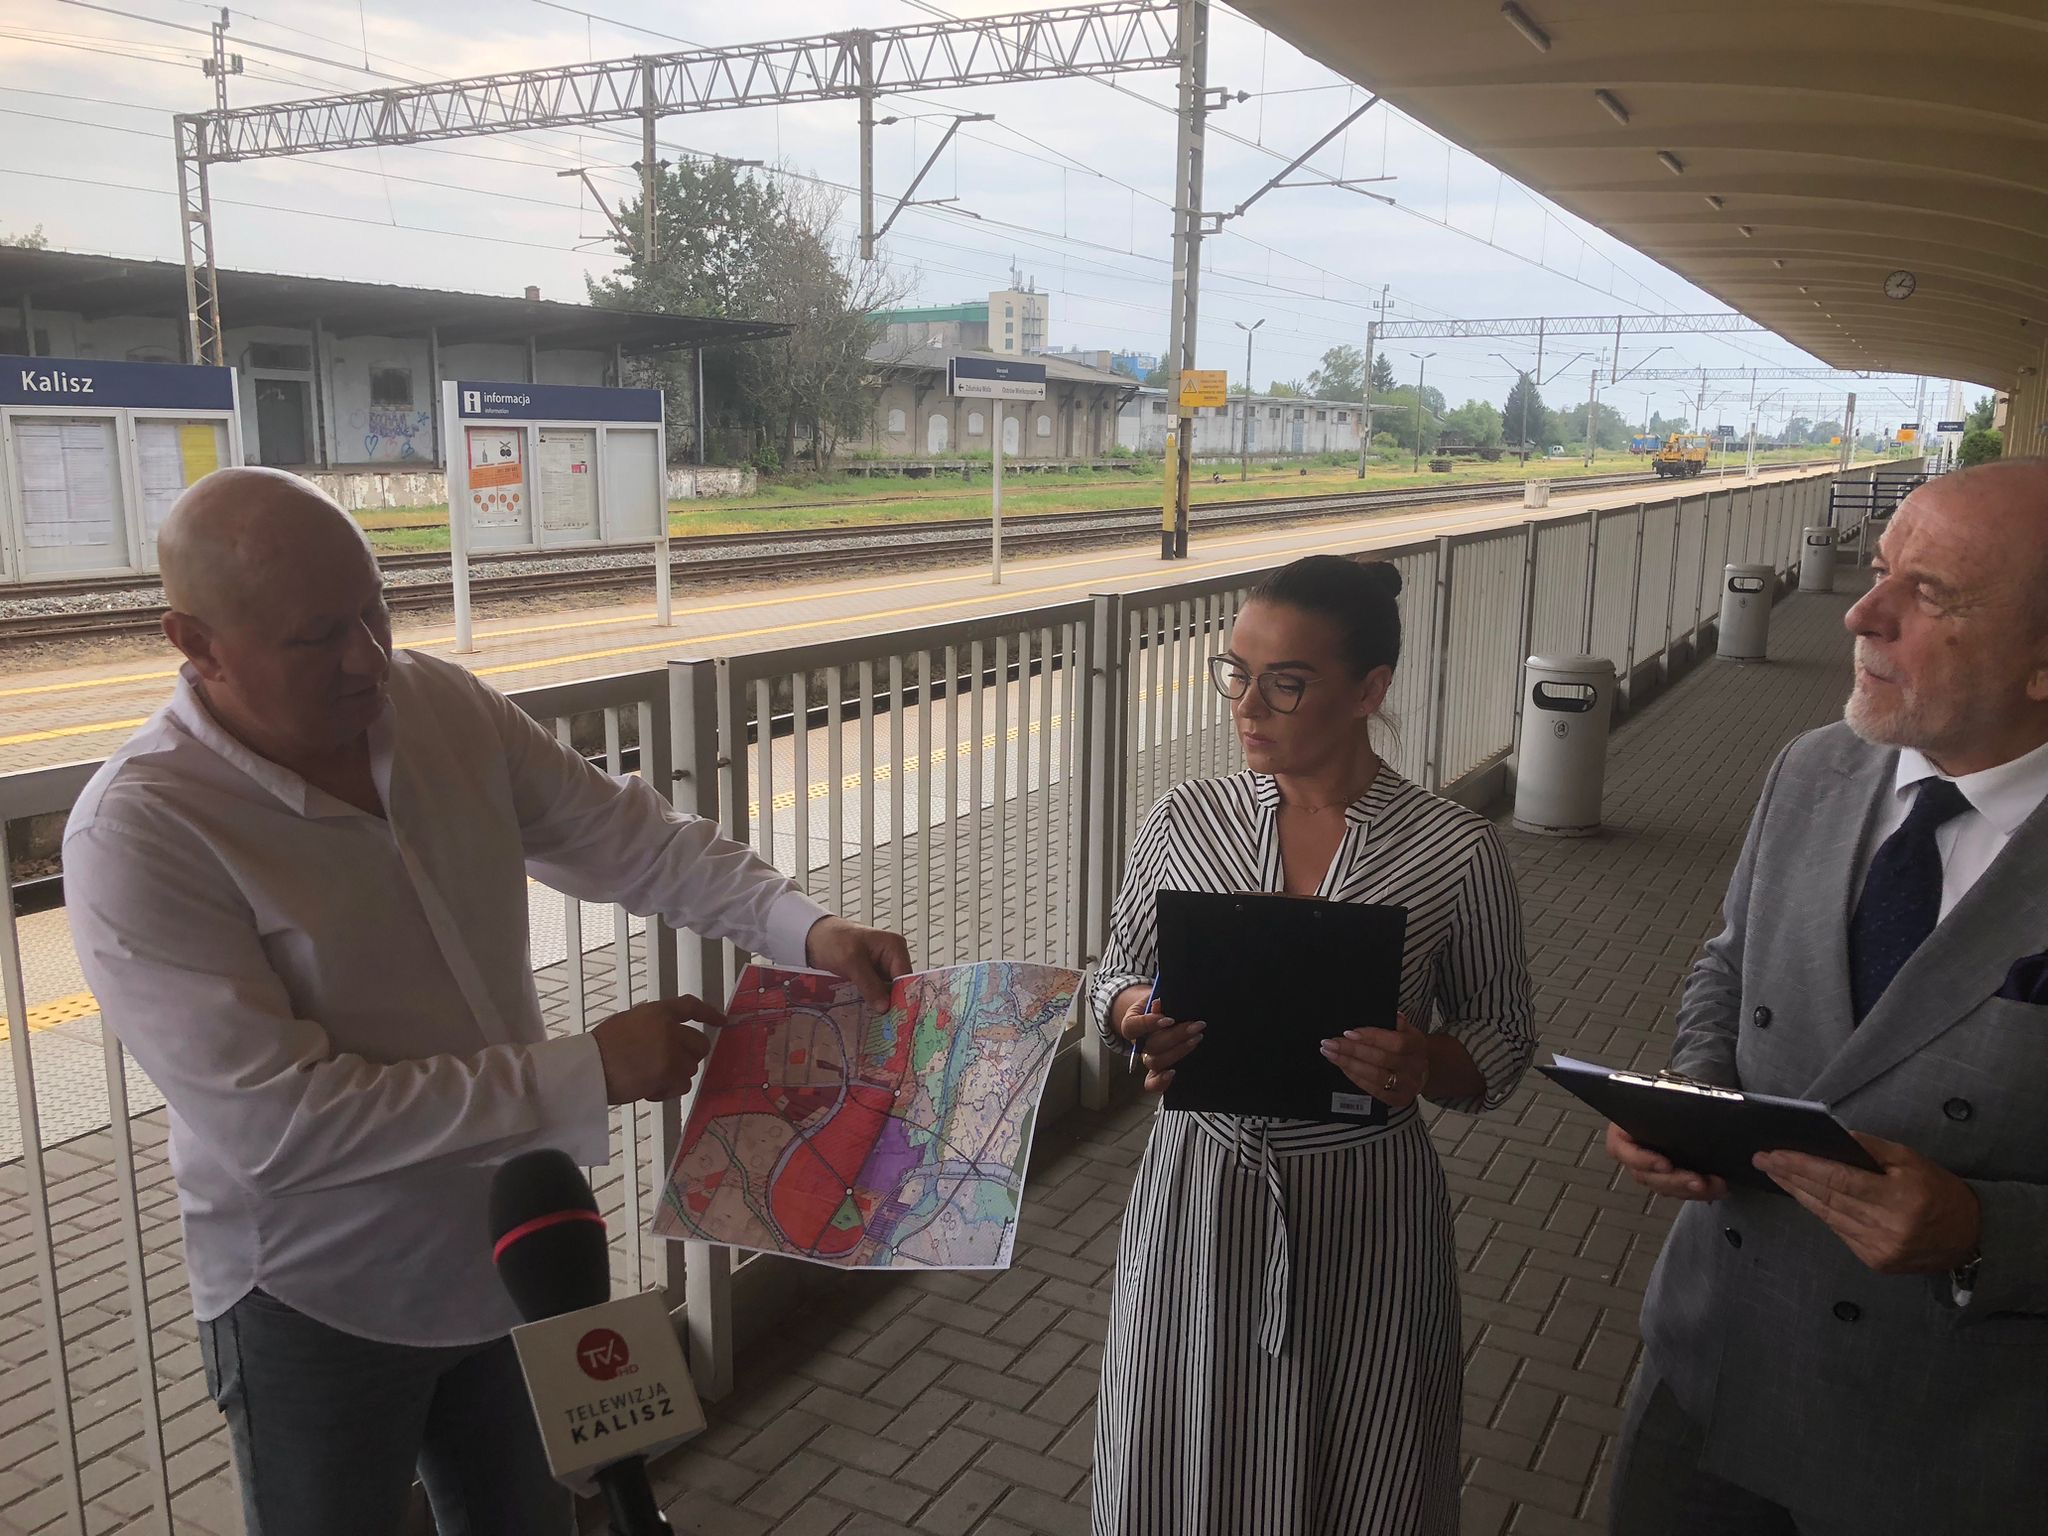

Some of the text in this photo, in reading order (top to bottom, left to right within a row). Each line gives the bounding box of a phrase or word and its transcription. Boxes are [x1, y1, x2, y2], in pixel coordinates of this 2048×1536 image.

[21, 370, 94, 393] Kalisz
[483, 392, 531, 406] informacja
[616, 1363, 640, 1377] HD
[564, 1381, 668, 1425] TELEWIZJA
[570, 1398, 675, 1445] KALISZ
